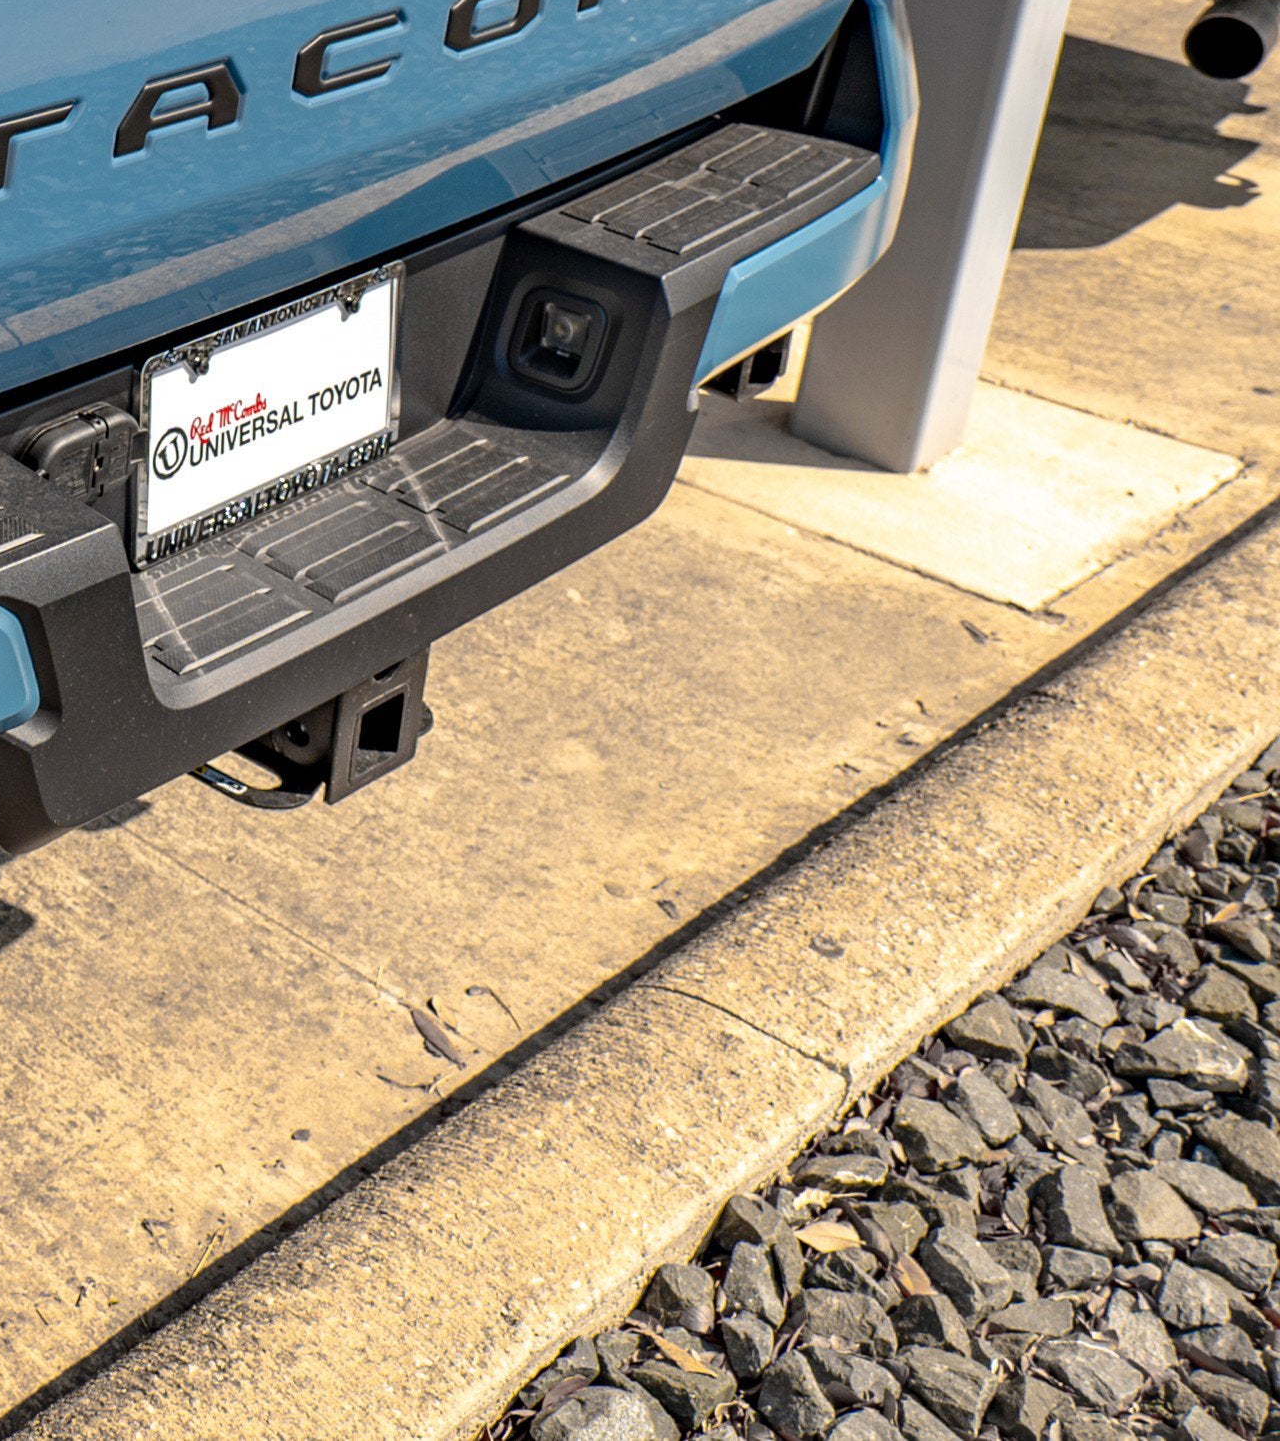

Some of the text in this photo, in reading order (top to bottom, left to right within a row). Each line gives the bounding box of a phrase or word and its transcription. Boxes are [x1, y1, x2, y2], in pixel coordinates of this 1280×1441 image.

[212, 325, 247, 348] SAN
[189, 401, 304, 467] UNIVERSAL
[308, 367, 382, 415] TOYOTA
[190, 412, 214, 444] Red
[146, 432, 392, 562] UNIVERSALTOYOTA.COM
